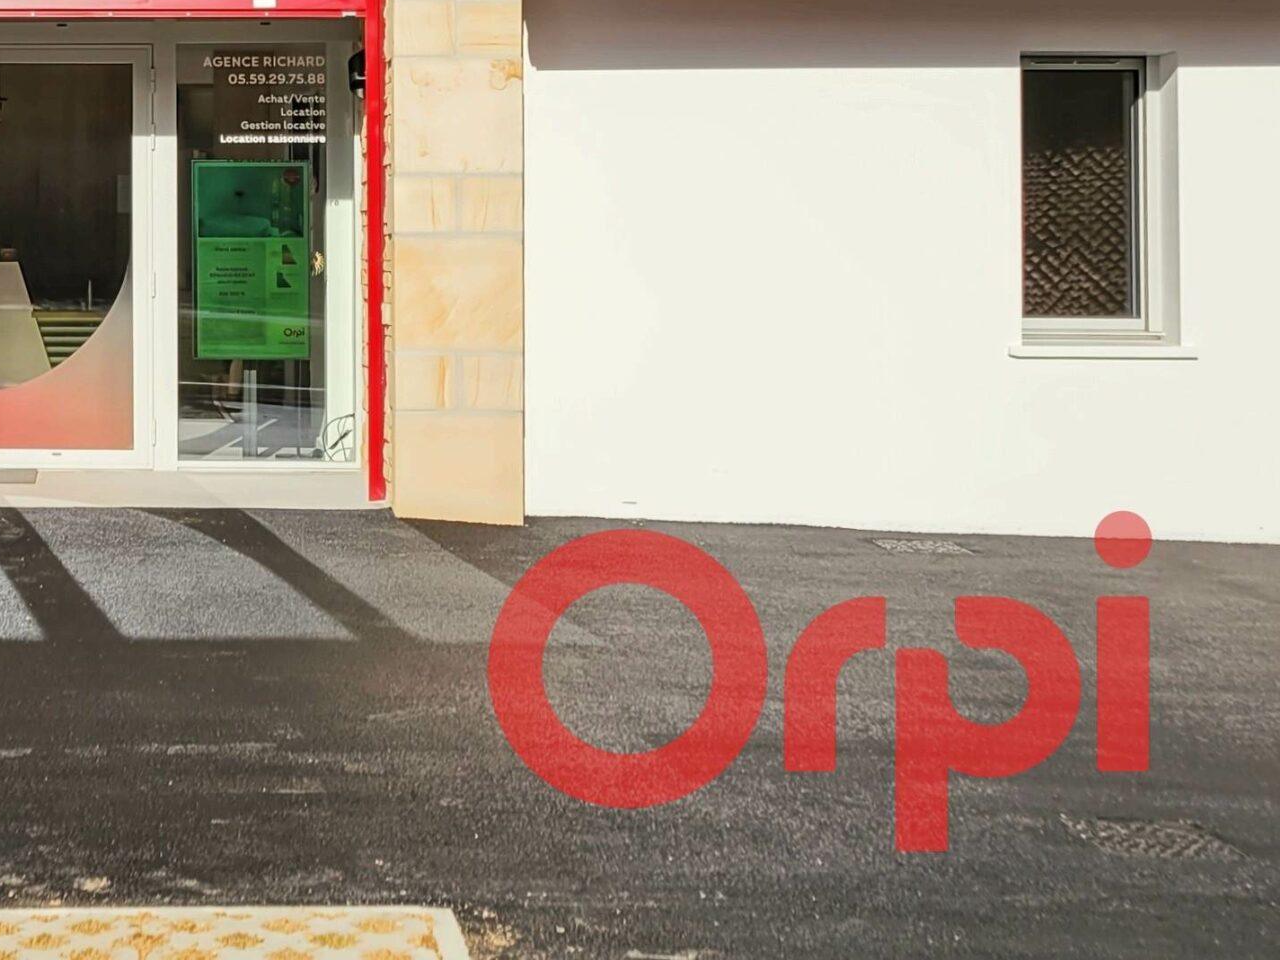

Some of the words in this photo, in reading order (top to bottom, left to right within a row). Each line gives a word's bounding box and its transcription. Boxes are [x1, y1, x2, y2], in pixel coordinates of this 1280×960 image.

[203, 56, 260, 68] AGENCE
[263, 56, 326, 68] RICHARD
[227, 73, 326, 86] 05.59.29.75.88
[257, 93, 326, 104] Achat/Vente
[280, 107, 326, 117] Location
[240, 120, 282, 131] Gestion
[283, 120, 326, 131] locative
[220, 134, 266, 144] Location
